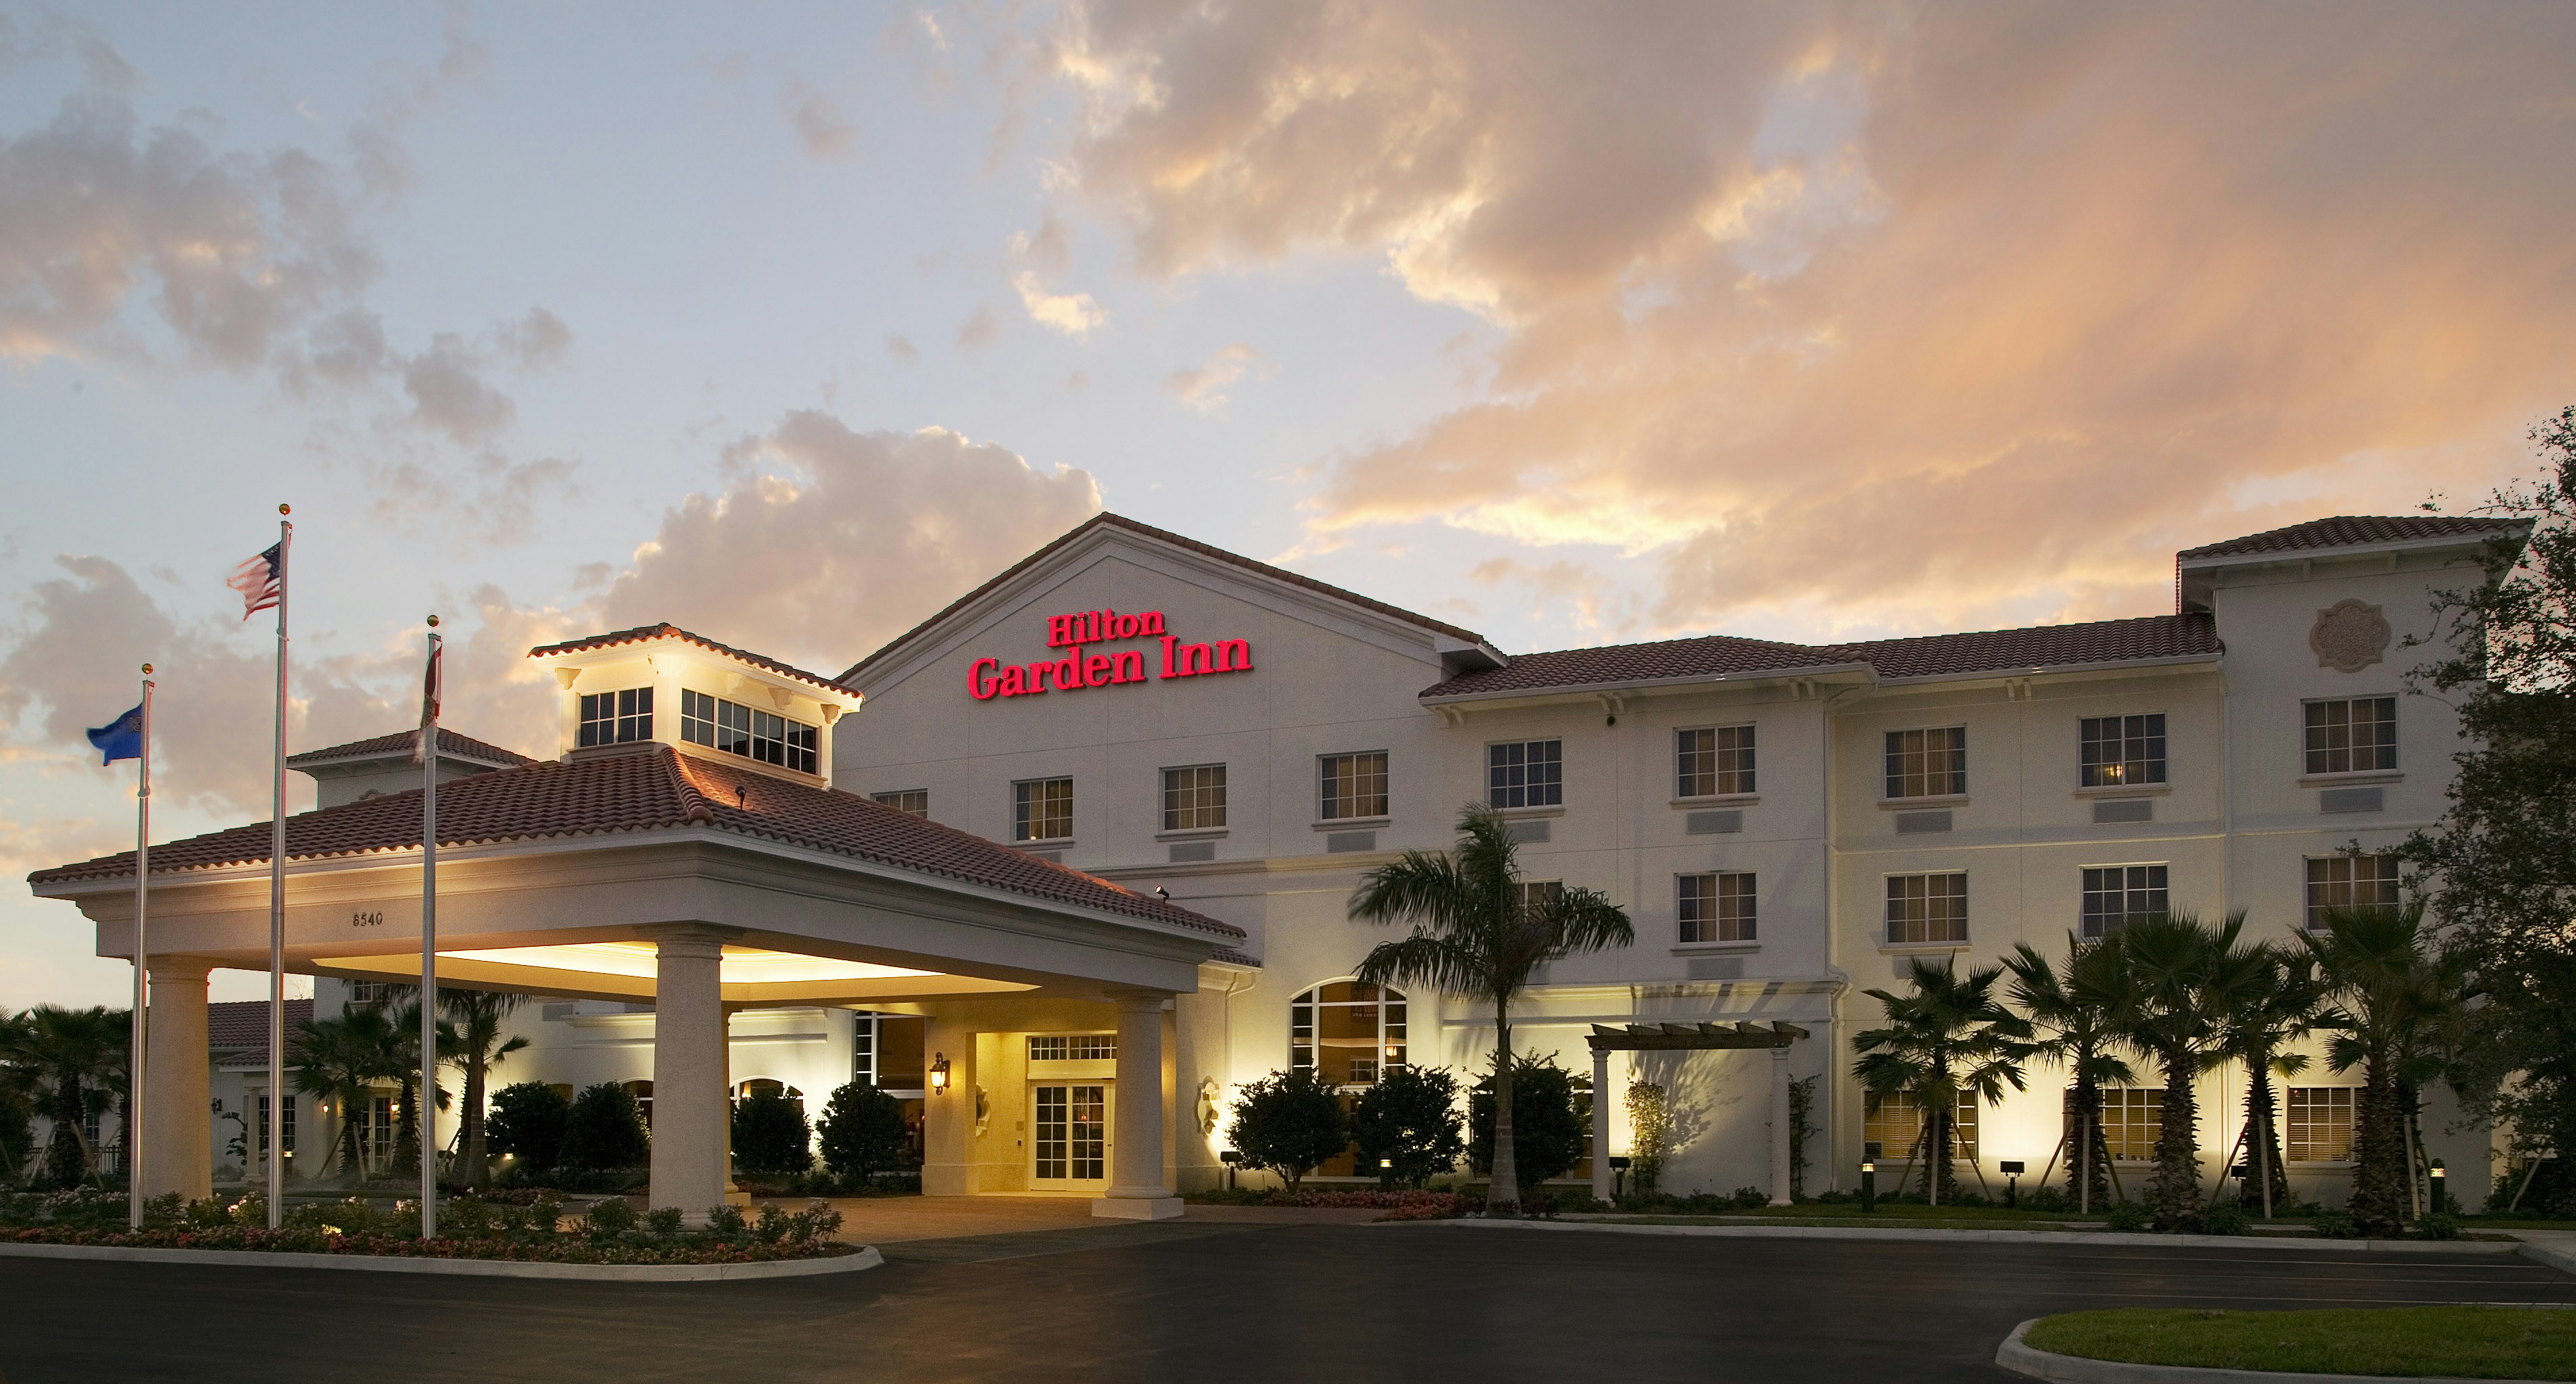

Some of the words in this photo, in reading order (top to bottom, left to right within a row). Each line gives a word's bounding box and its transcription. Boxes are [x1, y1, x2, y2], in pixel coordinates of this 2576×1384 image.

[1046, 609, 1165, 647] Hilton
[967, 647, 1146, 700] Garden
[1159, 635, 1253, 679] Inn
[353, 912, 383, 926] 8540
